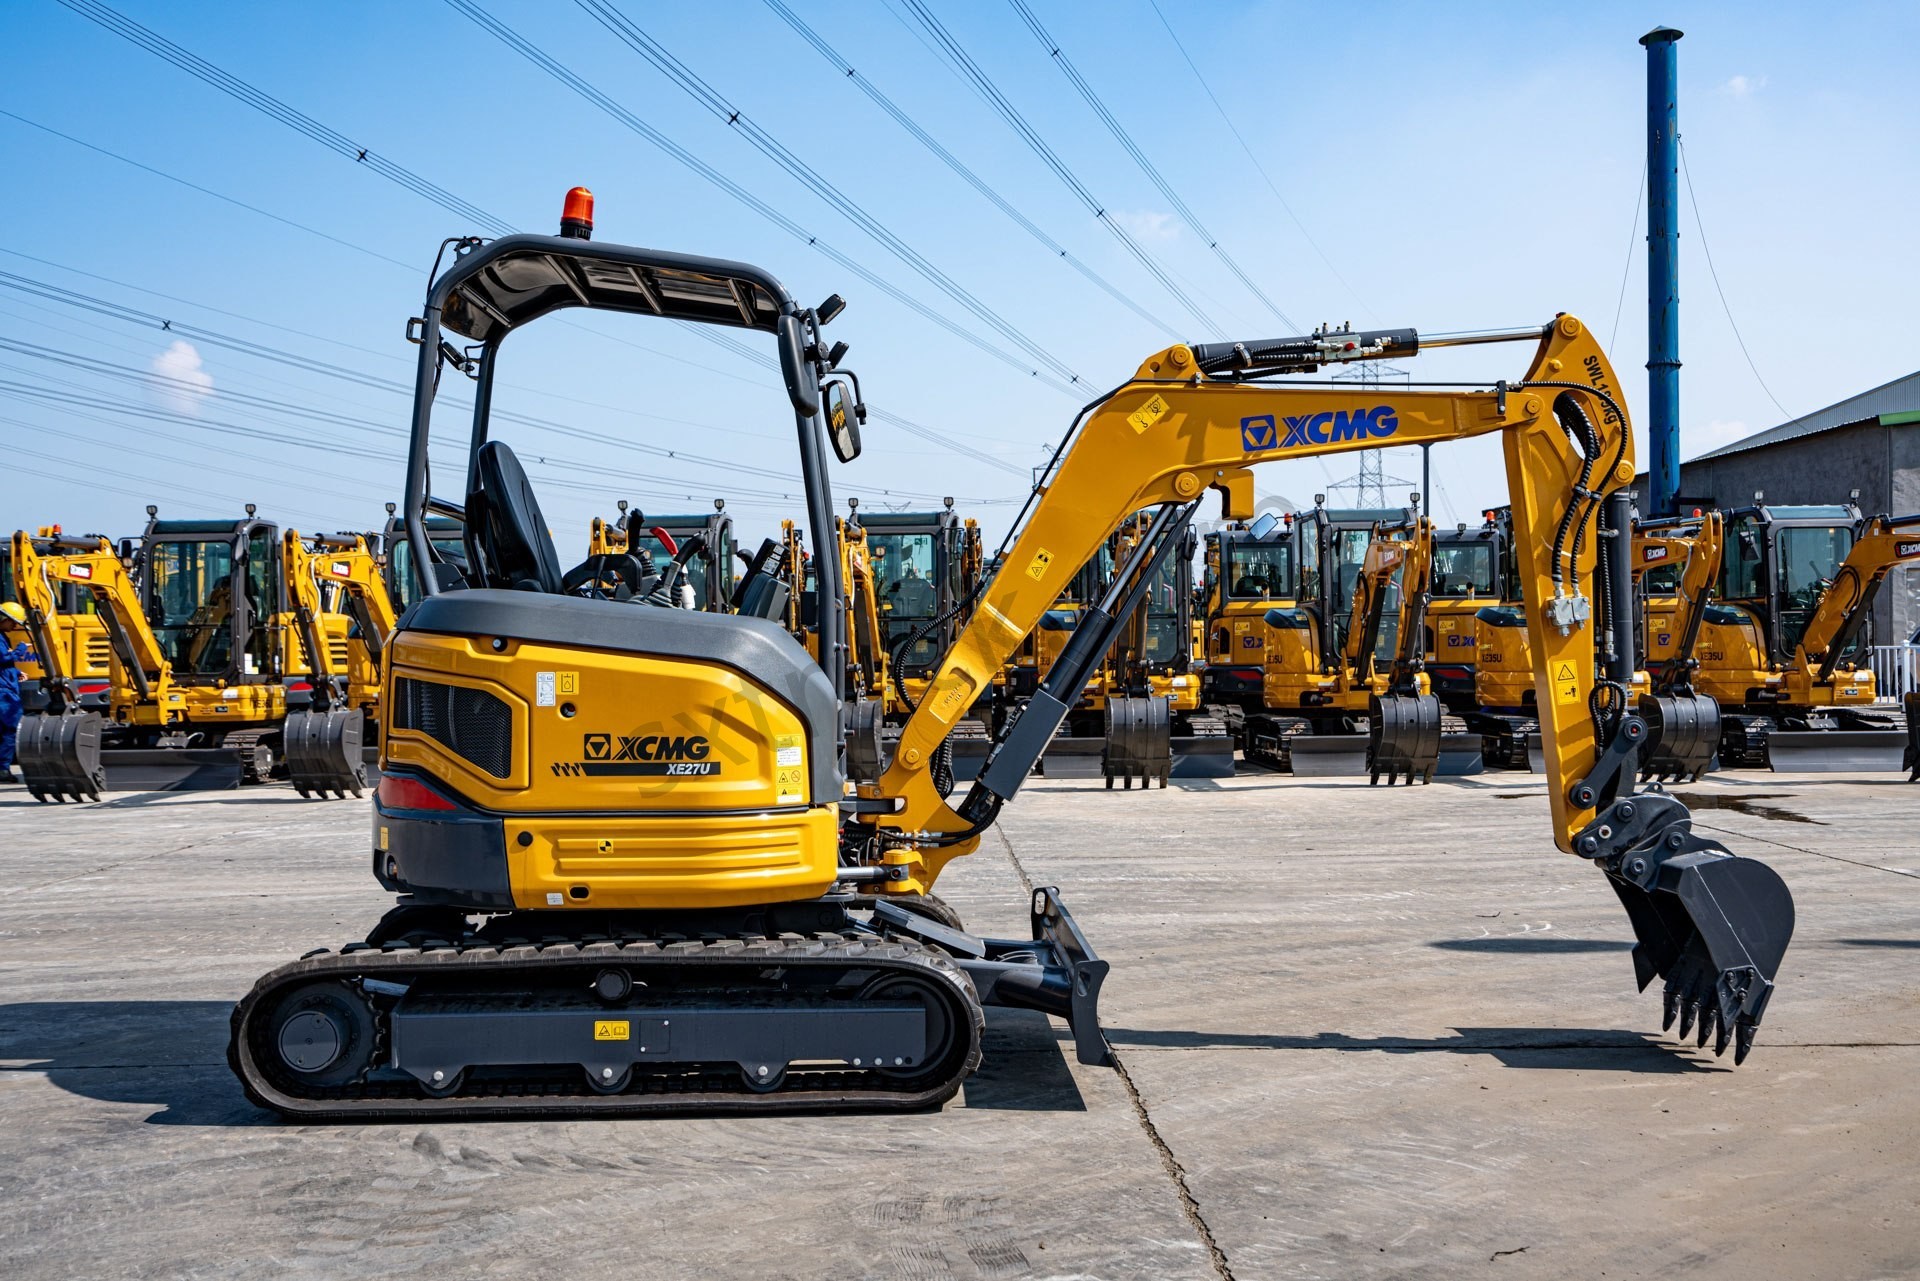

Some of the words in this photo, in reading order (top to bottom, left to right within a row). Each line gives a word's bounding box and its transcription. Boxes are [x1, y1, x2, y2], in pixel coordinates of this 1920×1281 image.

[1584, 355, 1604, 386] SWL
[1278, 405, 1398, 448] XCMG
[612, 736, 709, 760] XCMG
[667, 763, 710, 775] XE27U
